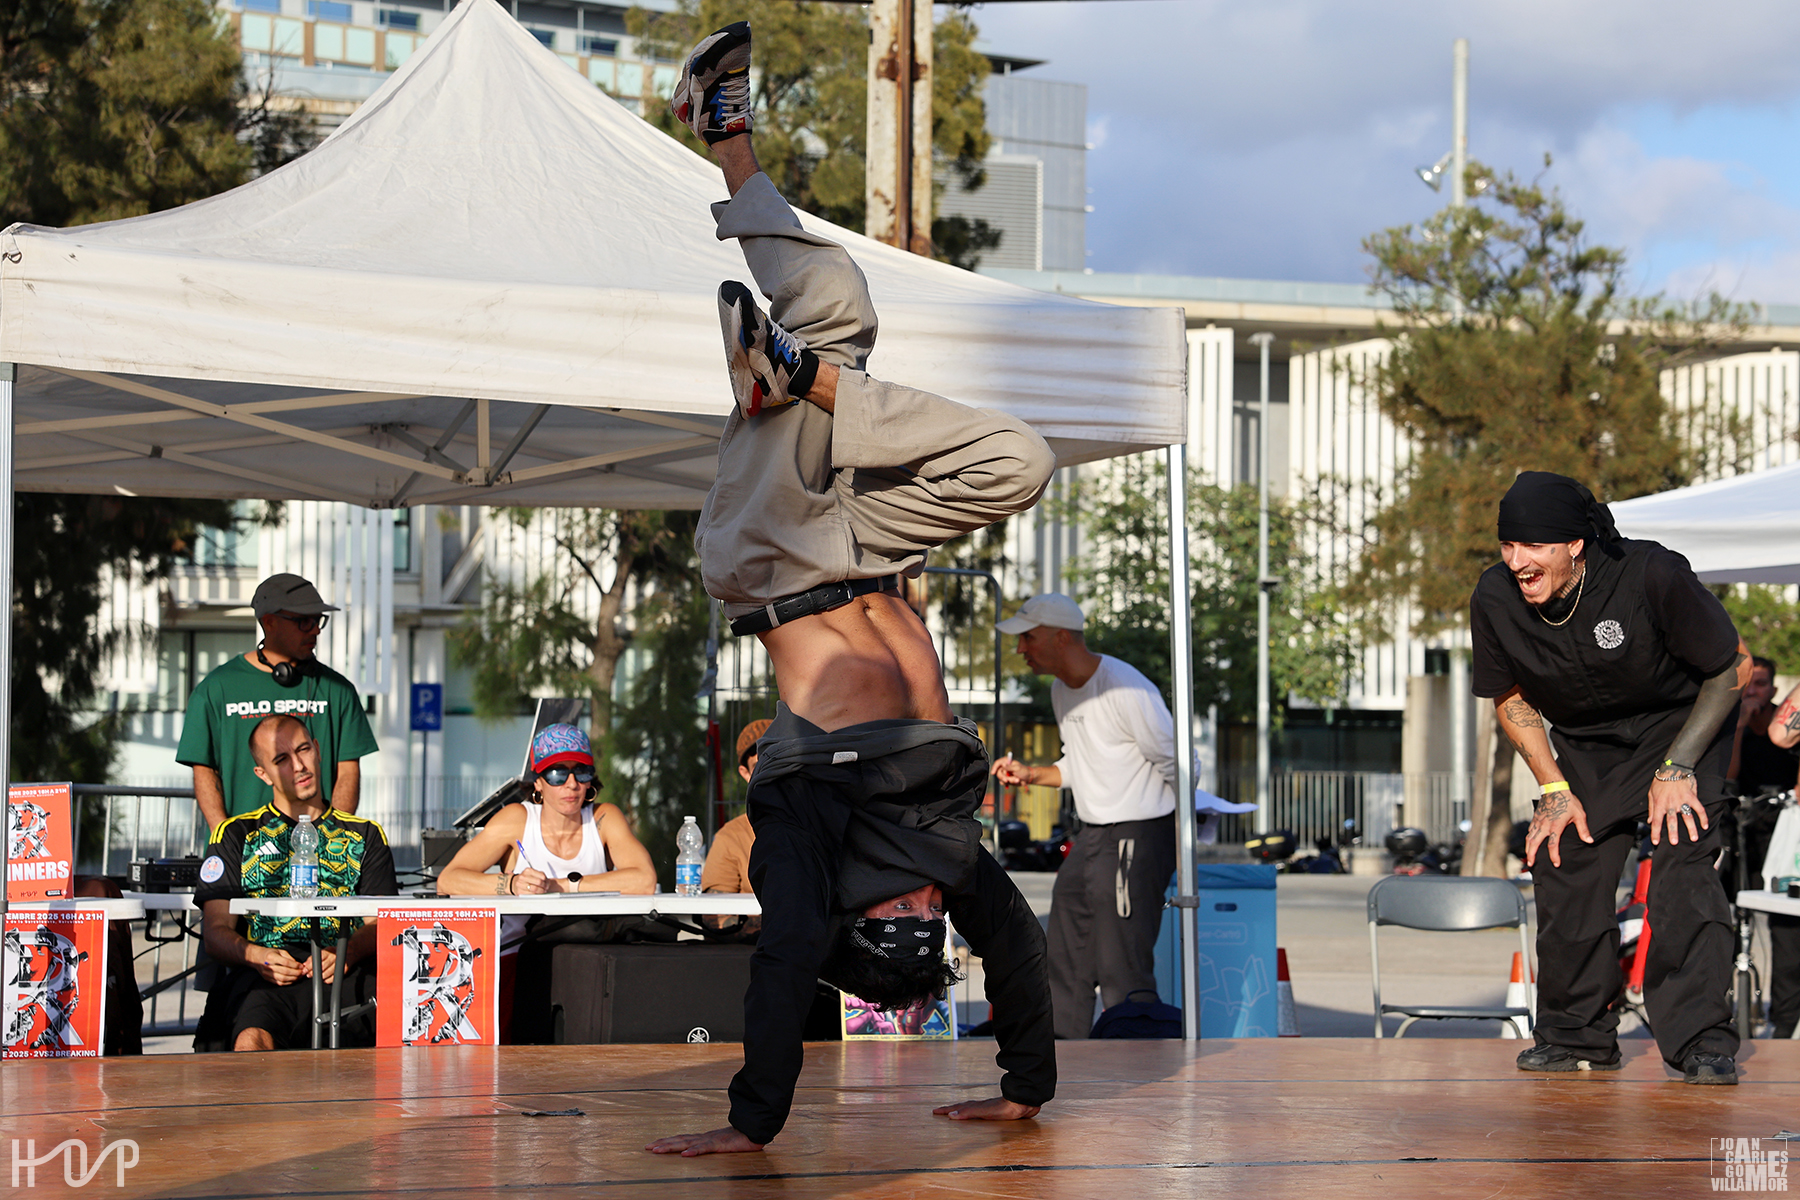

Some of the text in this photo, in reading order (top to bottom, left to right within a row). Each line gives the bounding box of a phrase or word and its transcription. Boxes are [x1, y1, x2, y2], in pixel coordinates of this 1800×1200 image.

[226, 699, 328, 716] POLO SPORT
[419, 689, 435, 708] P
